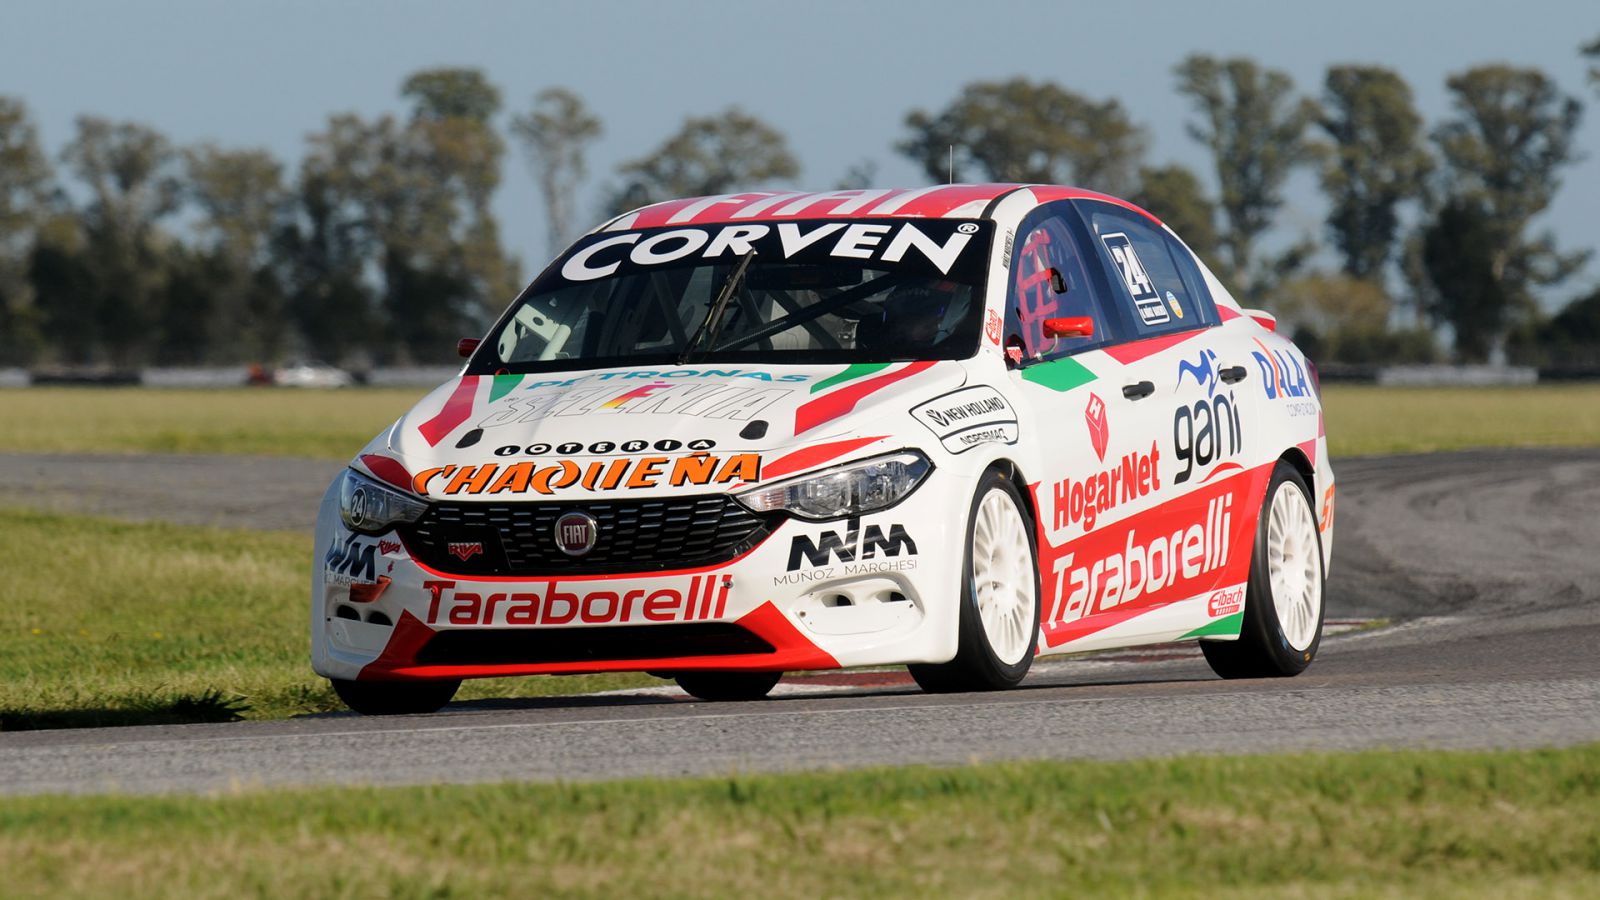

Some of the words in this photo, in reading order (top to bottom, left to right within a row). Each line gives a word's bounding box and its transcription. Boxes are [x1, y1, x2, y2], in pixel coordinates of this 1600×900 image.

[665, 184, 978, 225] FIAT
[561, 222, 973, 276] CORVEN
[1110, 245, 1152, 295] 24
[525, 369, 811, 389] PETRONAS
[1252, 337, 1312, 399] DALA
[943, 406, 970, 422] NEW
[963, 396, 1006, 417] HOLLAND
[496, 439, 714, 456] LOTERIA
[1174, 390, 1242, 485] gani
[413, 452, 763, 495] CHAQUEÑA
[1054, 440, 1160, 531] HogarNet
[351, 494, 364, 519] 24
[563, 524, 587, 544] FIAT
[774, 568, 835, 586] MUÑOZ
[844, 559, 918, 576] MARCHESI
[1050, 492, 1232, 630] Taraborelli
[423, 573, 733, 625] Taraborelli
[1208, 586, 1243, 617] Eibach
